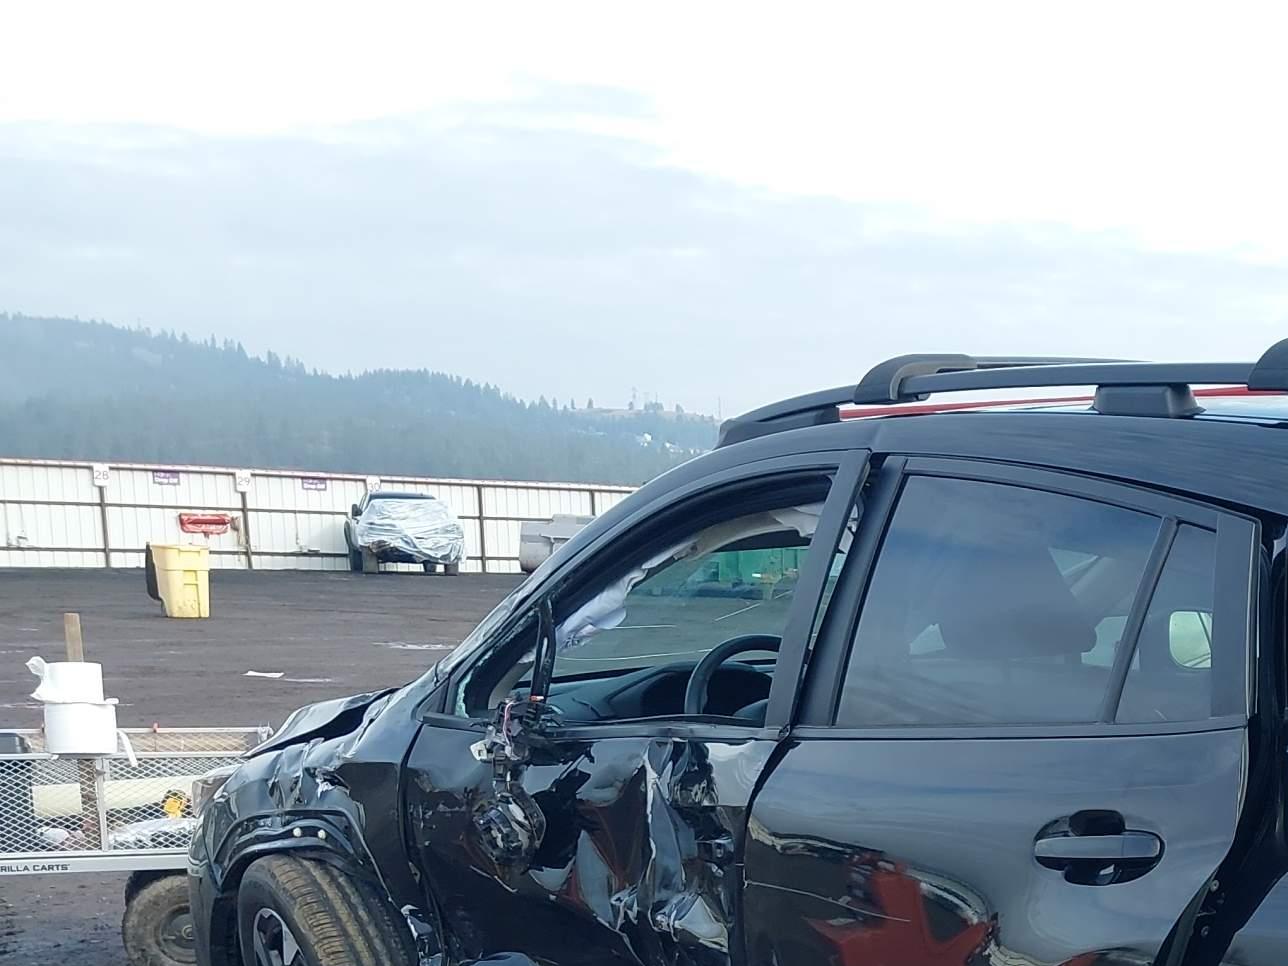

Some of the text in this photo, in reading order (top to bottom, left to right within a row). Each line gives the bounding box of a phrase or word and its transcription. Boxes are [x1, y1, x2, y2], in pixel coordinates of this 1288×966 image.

[94, 470, 109, 480] 28
[238, 477, 250, 486] 29
[368, 482, 380, 492] 30
[33, 864, 69, 872] CARTS
